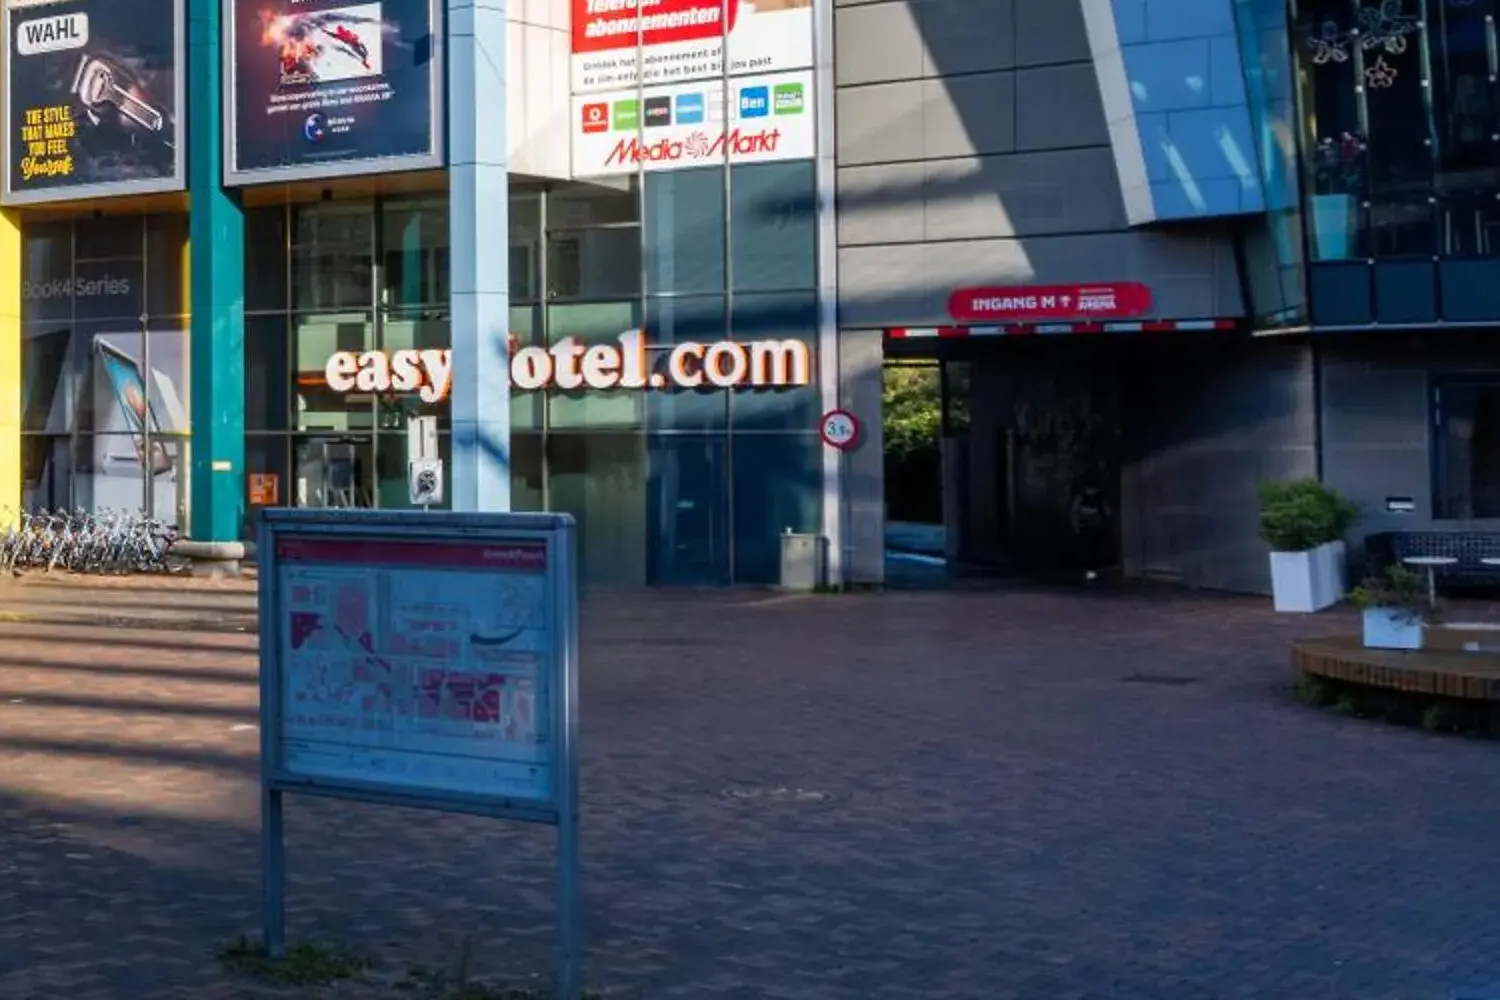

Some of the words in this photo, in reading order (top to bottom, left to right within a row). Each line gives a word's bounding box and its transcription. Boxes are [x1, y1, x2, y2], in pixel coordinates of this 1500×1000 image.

[25, 15, 80, 45] WAHL
[584, 6, 720, 38] abonnementen
[644, 48, 709, 66] abonnement
[748, 55, 773, 70] past
[741, 97, 765, 110] Ben
[604, 137, 683, 166] Media
[706, 128, 781, 157] Markt
[75, 273, 131, 296] Series
[972, 296, 1037, 311] INGANG
[325, 328, 810, 403] easyotel.com
